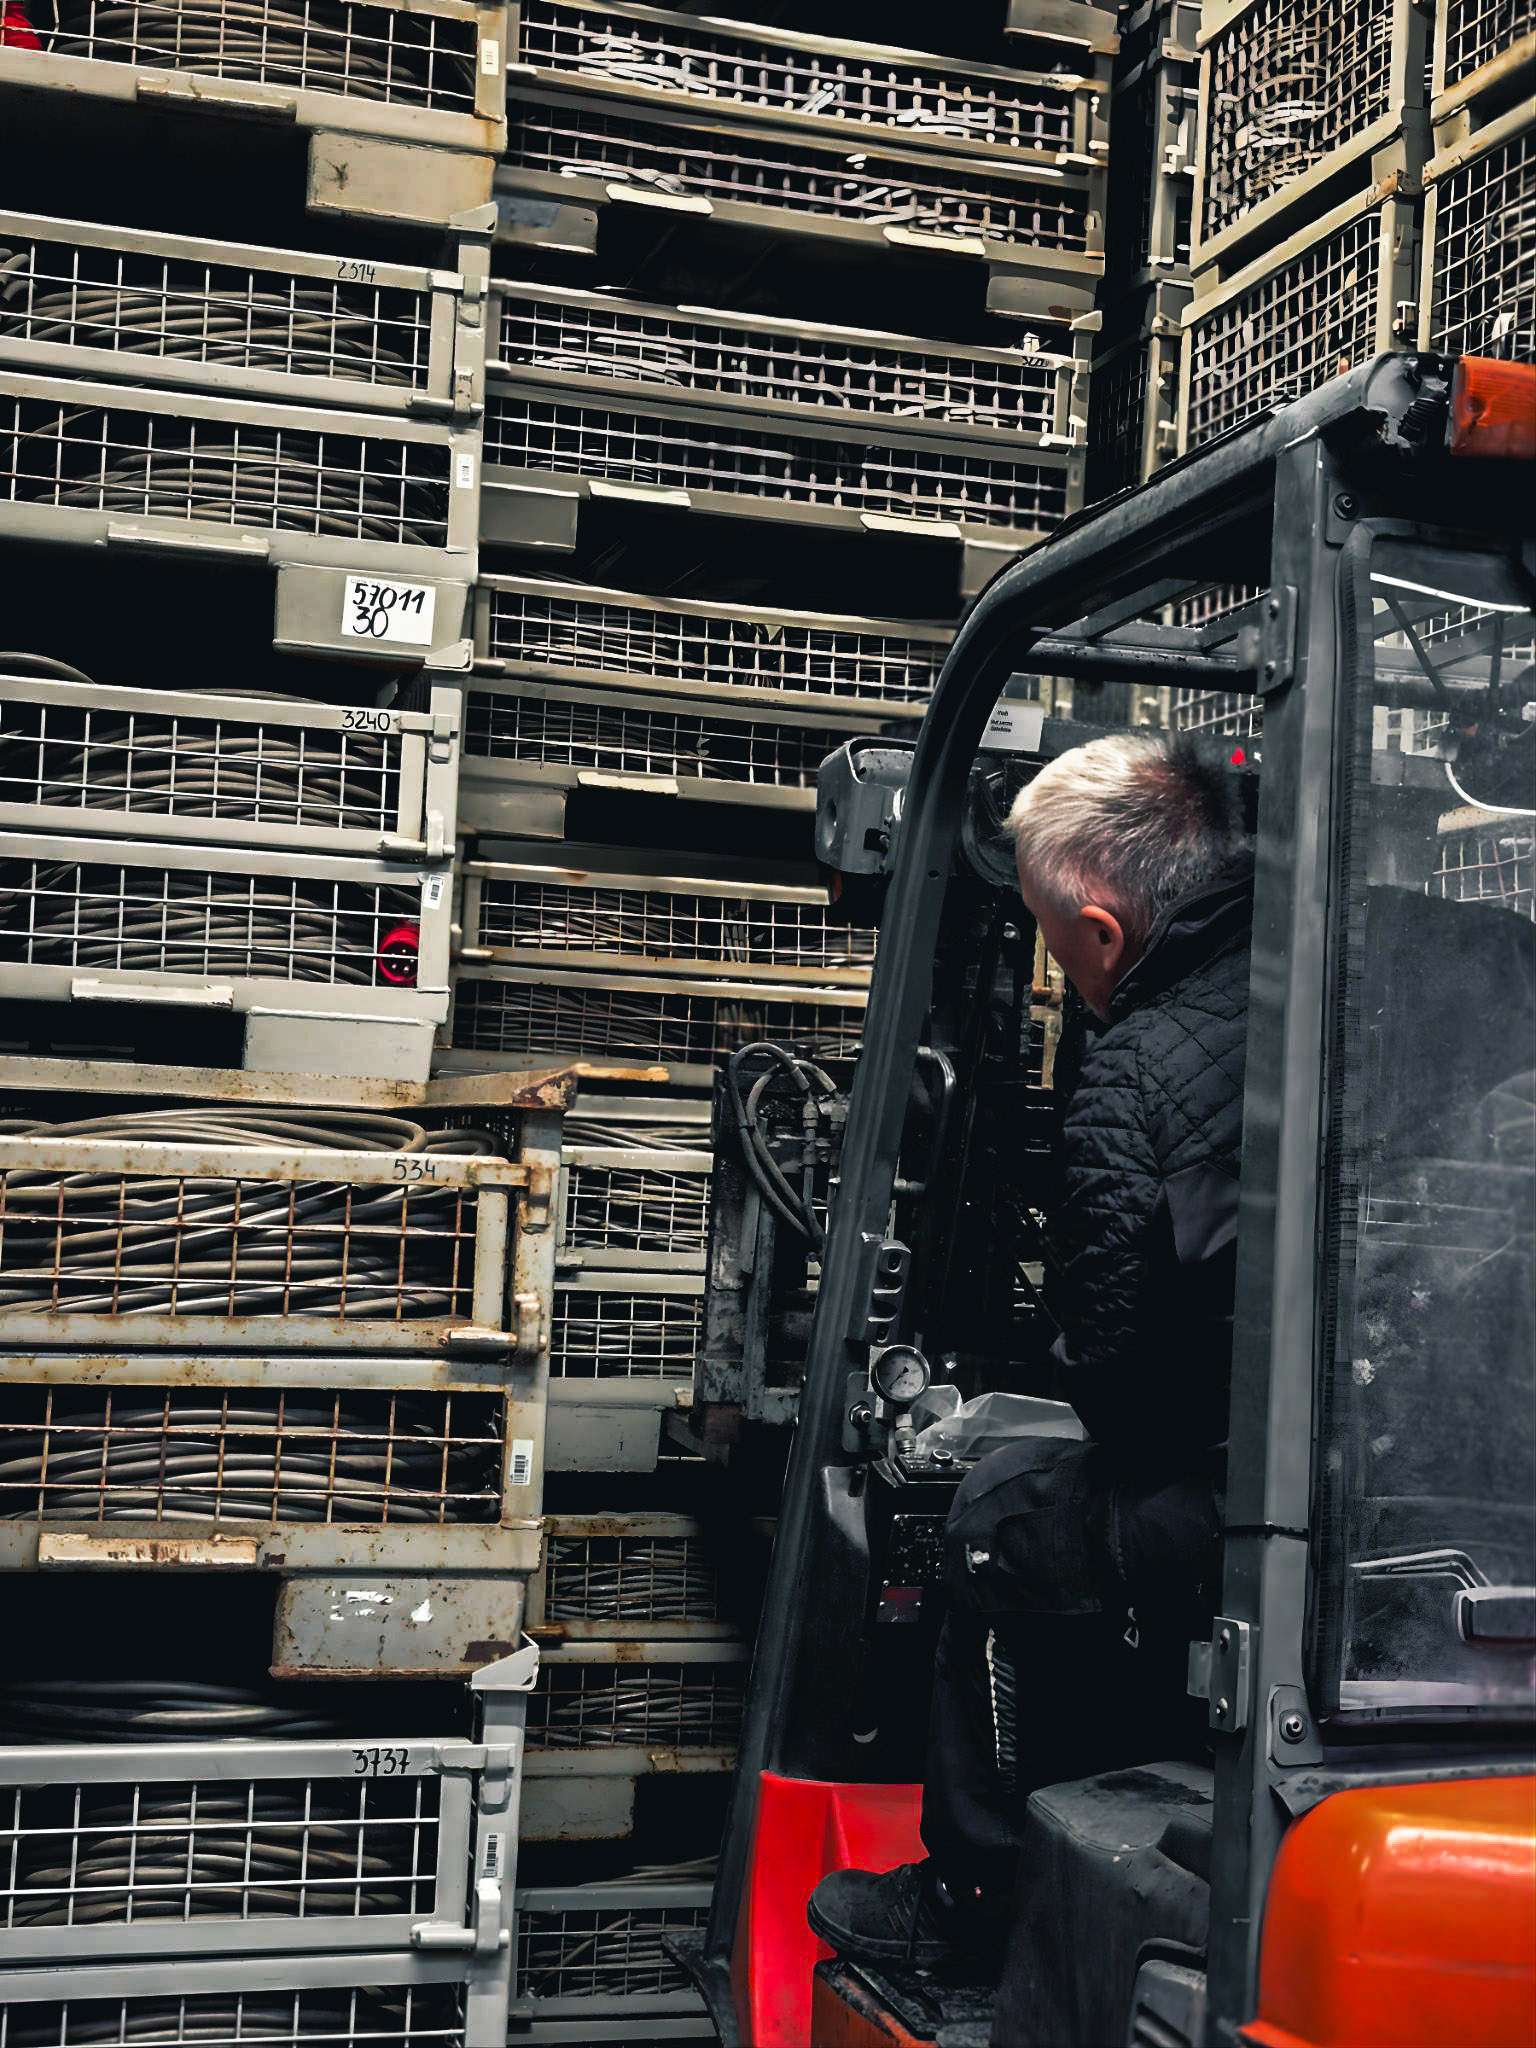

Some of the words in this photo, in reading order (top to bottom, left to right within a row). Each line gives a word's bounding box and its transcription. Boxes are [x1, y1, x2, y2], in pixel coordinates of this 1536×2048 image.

[352, 583, 426, 614] 57011
[352, 606, 389, 638] 30
[341, 710, 391, 731] 3240
[392, 1157, 436, 1181] 534
[352, 1748, 410, 1777] 3737
